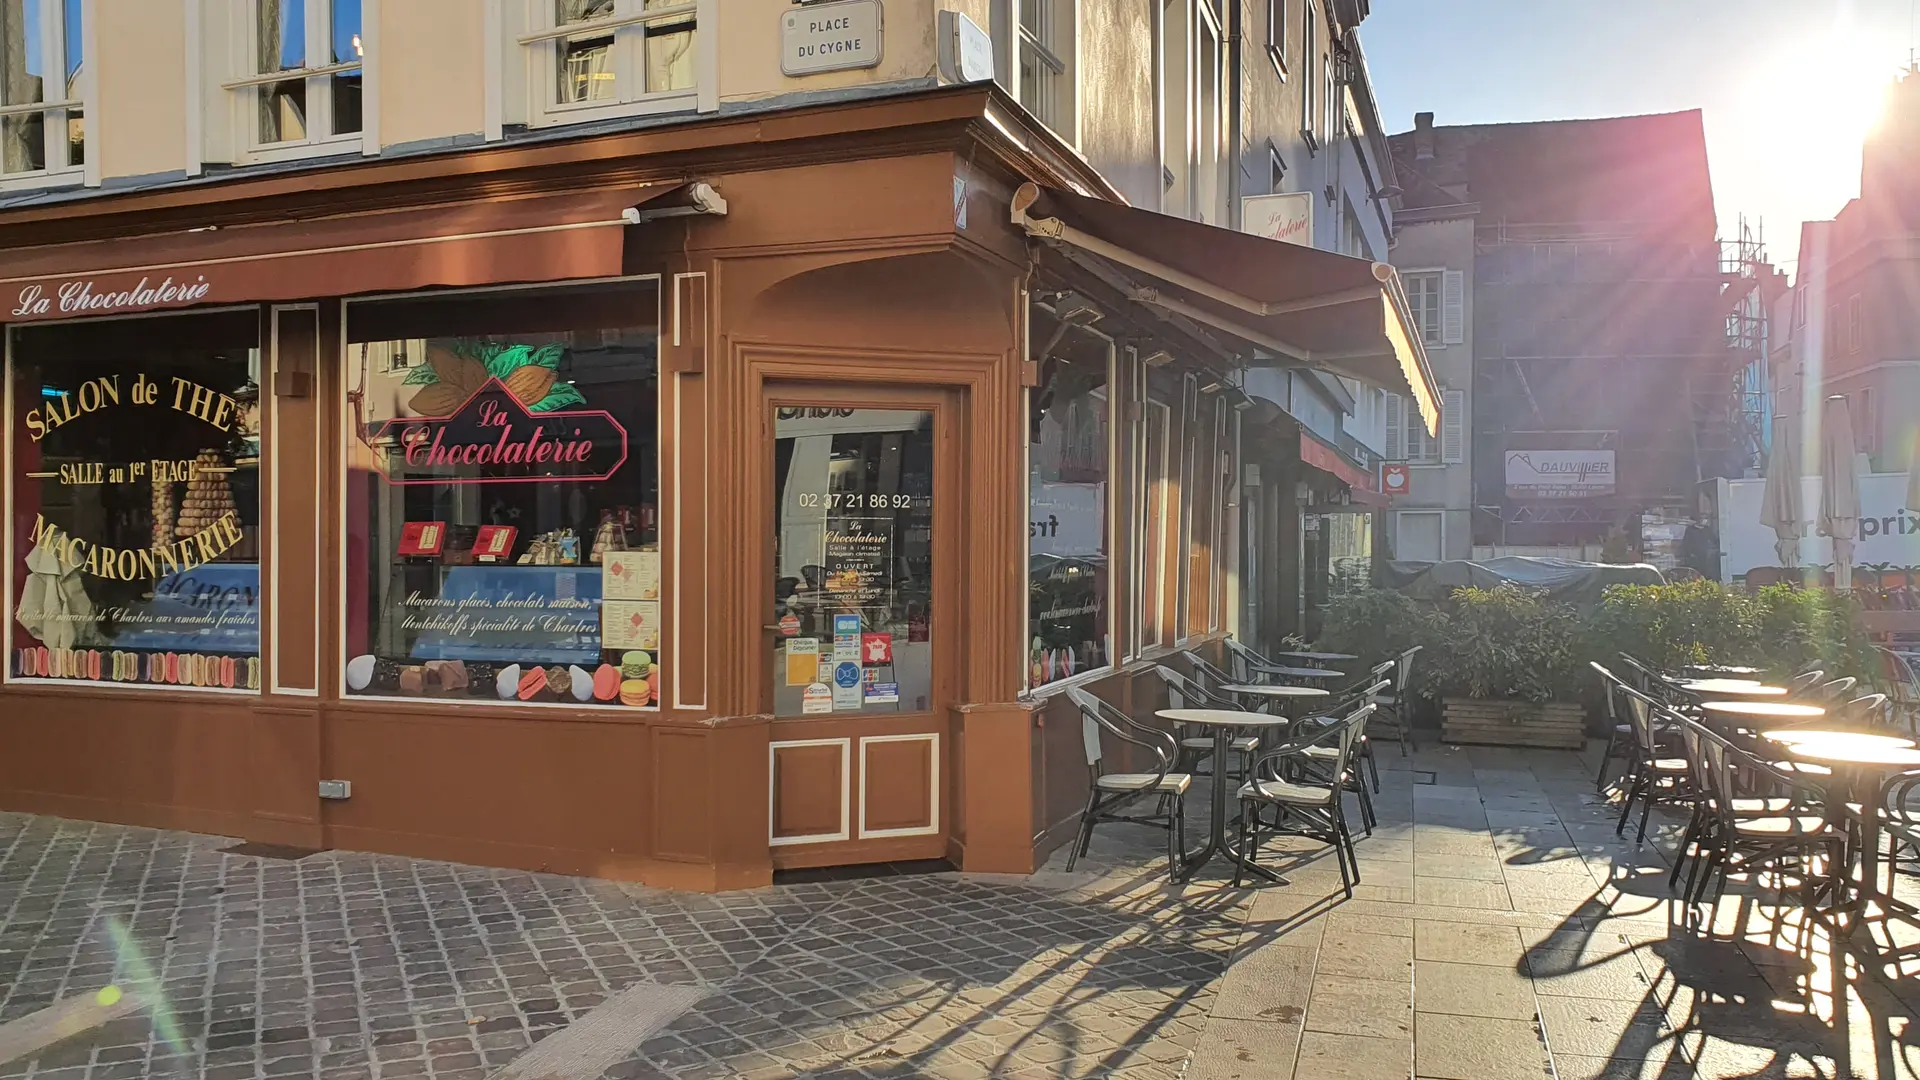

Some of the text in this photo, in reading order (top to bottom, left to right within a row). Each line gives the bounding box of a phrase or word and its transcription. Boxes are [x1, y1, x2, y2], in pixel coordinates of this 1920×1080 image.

[810, 17, 850, 33] PLACE
[798, 38, 861, 57] DU CYGNE
[11, 275, 210, 316] La Chocolaterie
[26, 374, 120, 443] SALON
[131, 373, 158, 405] de
[476, 399, 508, 428] La
[401, 424, 593, 467] Chocolaterie
[60, 459, 197, 485] SALLE au 1er ETAGE
[799, 493, 910, 508] 02 37 21 86 92
[824, 530, 887, 543] Chocolaterie
[849, 521, 862, 530] La
[28, 511, 243, 581] MACARONNERIE
[398, 590, 456, 609] Macarons
[496, 591, 544, 609] chocolats
[96, 609, 106, 622] de
[109, 606, 153, 624] Chartres
[174, 611, 216, 625] amandes
[401, 611, 467, 636] Mentchikoffs
[522, 615, 536, 632] de
[538, 612, 597, 633] Chartres
